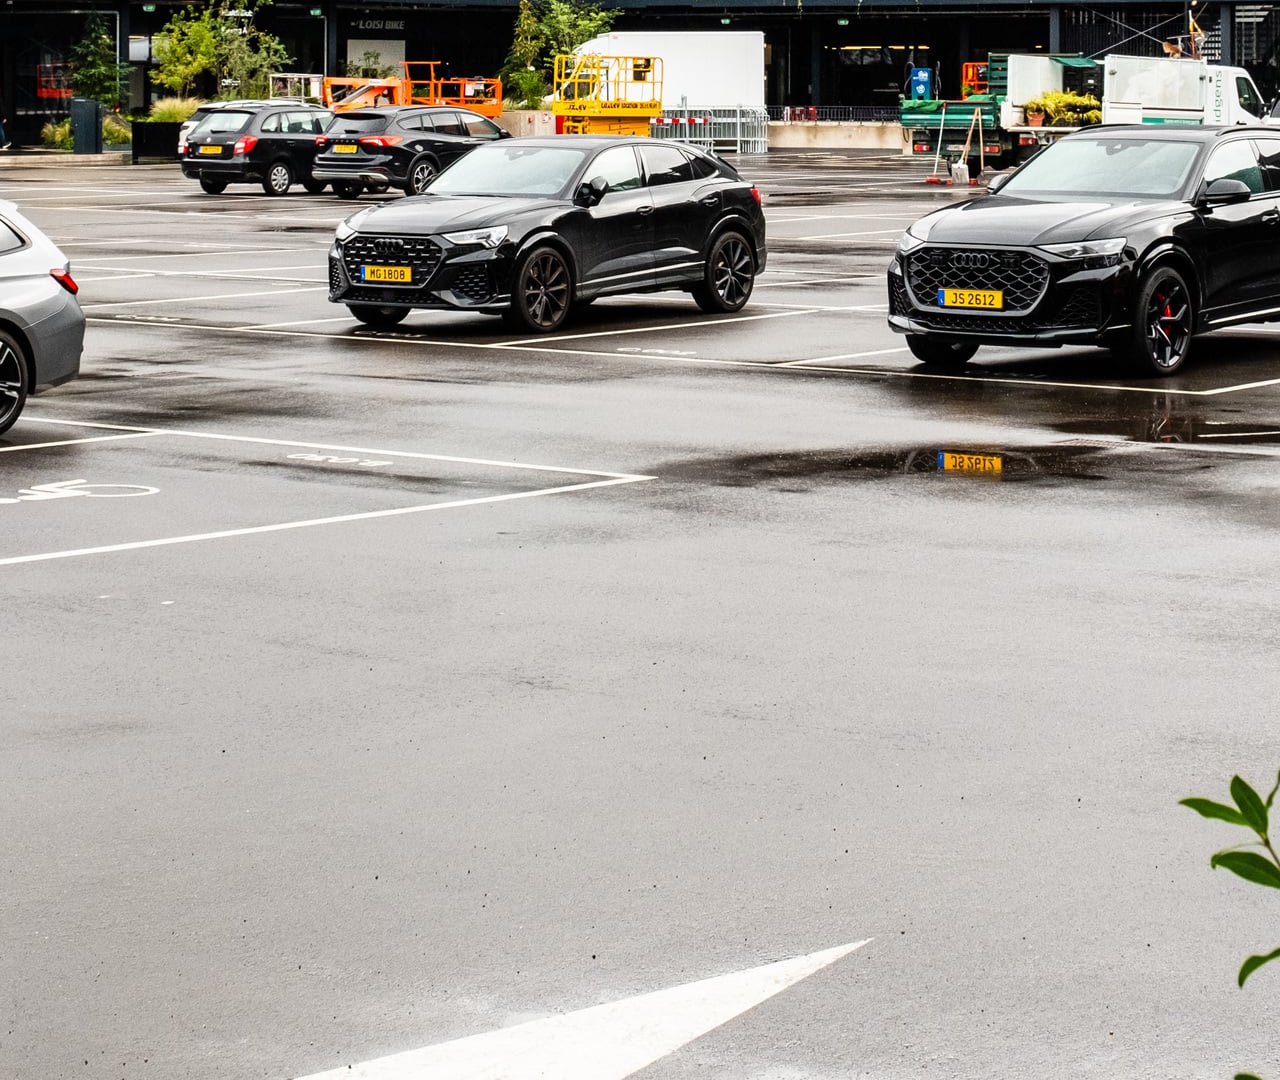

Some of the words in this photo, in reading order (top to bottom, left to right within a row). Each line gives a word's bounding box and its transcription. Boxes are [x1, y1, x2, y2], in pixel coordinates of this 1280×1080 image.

[385, 19, 406, 30] BIKE
[951, 292, 965, 305] JS
[967, 293, 995, 306] 2612
